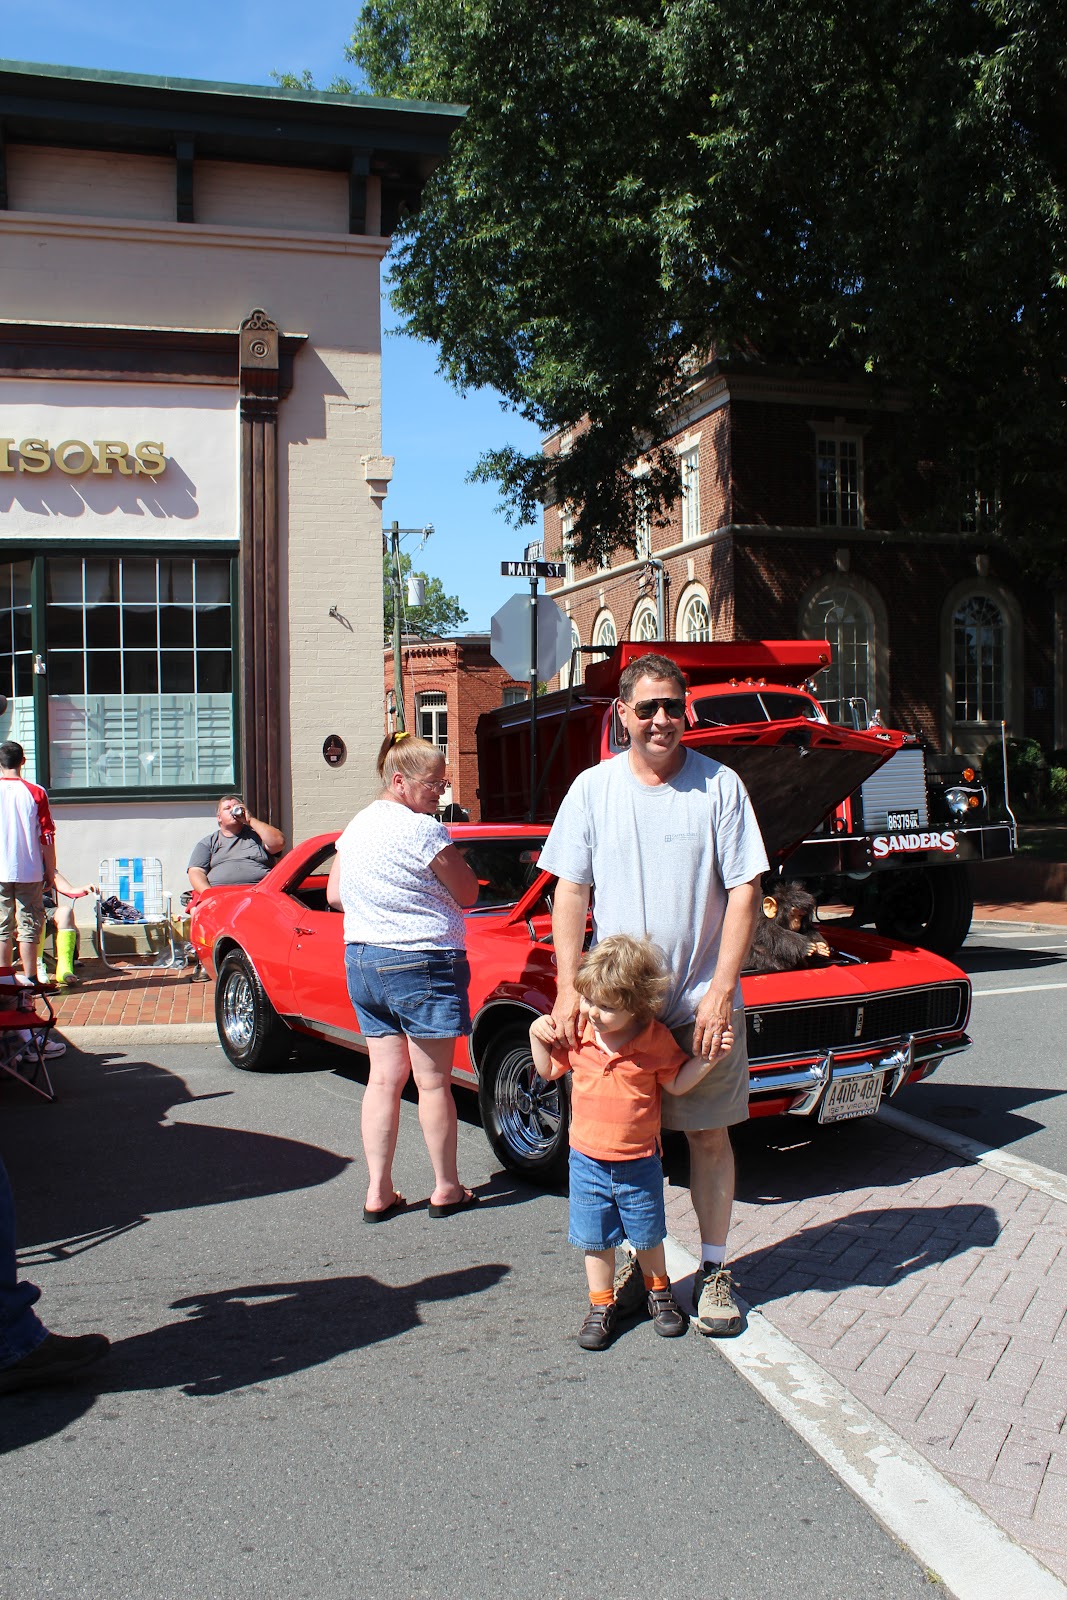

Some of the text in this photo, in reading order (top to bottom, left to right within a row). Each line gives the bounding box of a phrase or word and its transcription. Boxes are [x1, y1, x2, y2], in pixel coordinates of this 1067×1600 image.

[508, 562, 562, 577] MAIN ST.
[888, 813, 910, 829] 86379
[872, 831, 957, 858] SANDERS
[836, 1108, 875, 1120] CAMARO
